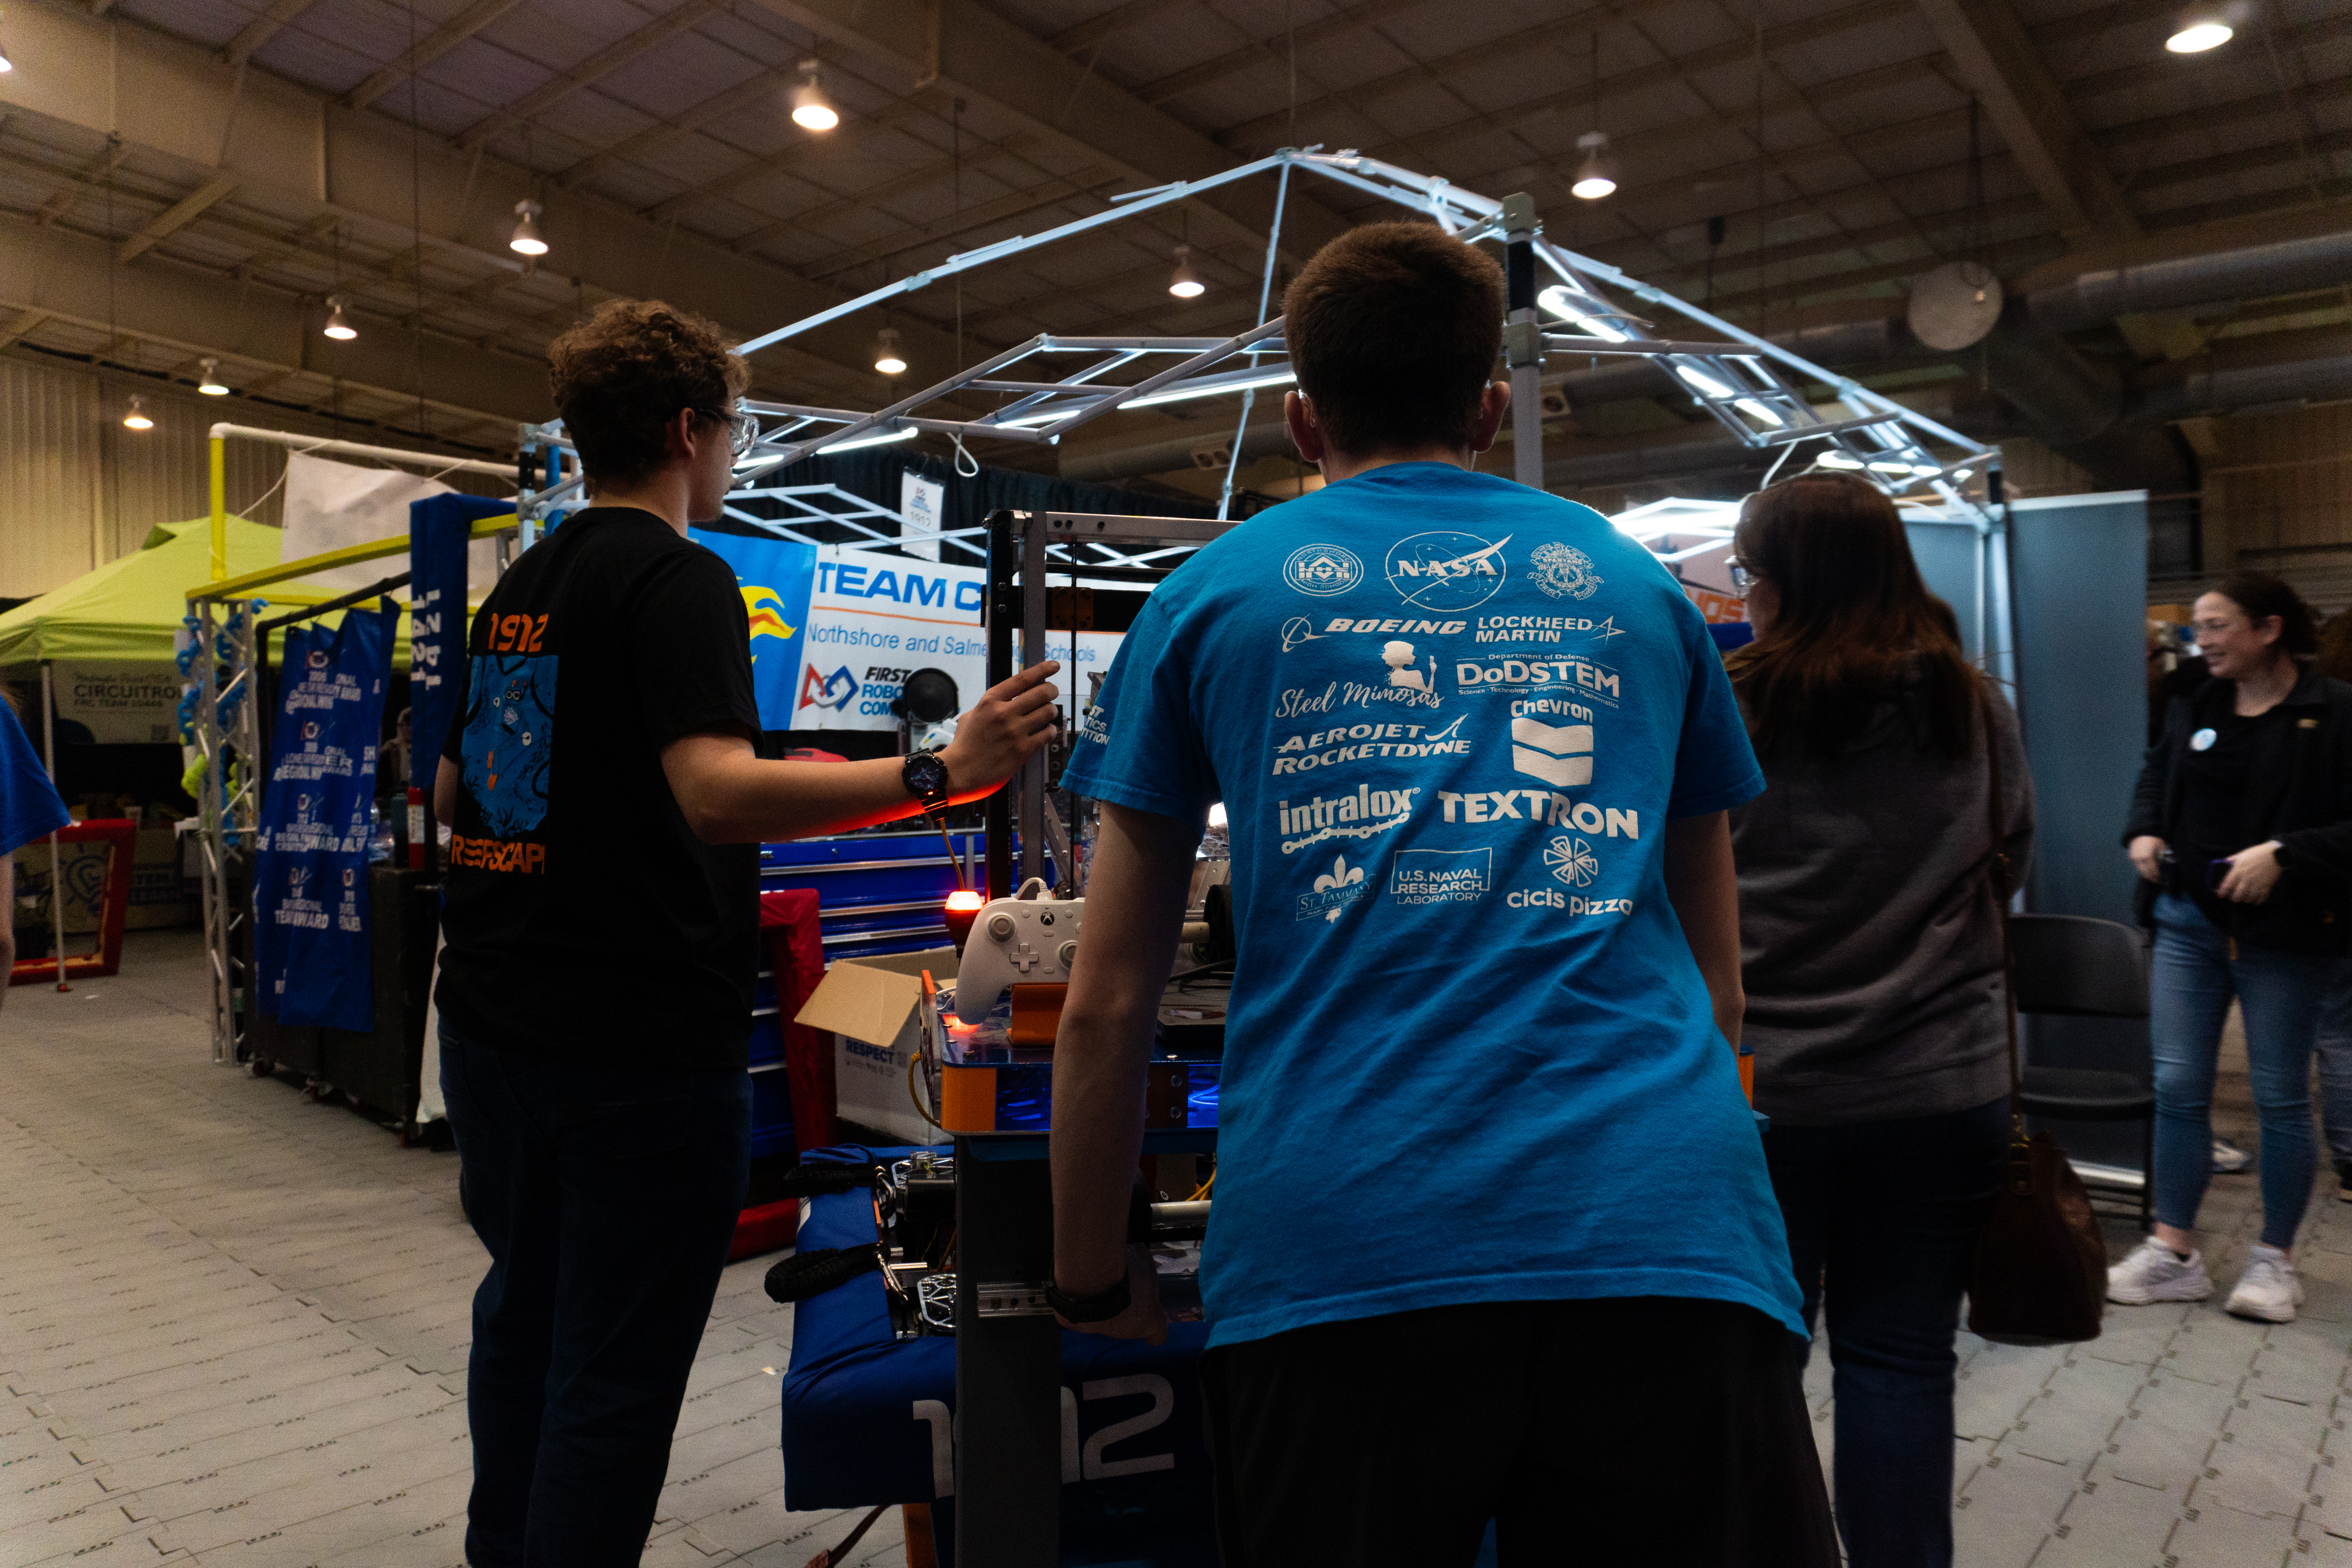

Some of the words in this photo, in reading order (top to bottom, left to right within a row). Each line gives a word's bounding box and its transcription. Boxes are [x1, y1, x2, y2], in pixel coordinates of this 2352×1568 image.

[1297, 548, 1350, 561] NORTHSHORE
[1397, 558, 1498, 577] NASA
[818, 562, 946, 608] TEAM
[955, 581, 982, 611] C
[1539, 583, 1556, 597] PRIDE
[1578, 585, 1595, 598] POWER
[488, 612, 549, 653] 1912
[1325, 618, 1467, 635] BOEING
[1477, 616, 1592, 630] LOCKHEED
[807, 623, 900, 649] Northshore
[905, 635, 940, 653] and
[944, 637, 986, 657] Salme
[1475, 630, 1561, 643] MARTIN
[865, 666, 911, 683] FIRST
[1457, 661, 1619, 698] DoDSTEM
[862, 684, 904, 699] ROBO
[1275, 681, 1337, 718] Steel
[1343, 682, 1445, 709] Mimosas
[1534, 685, 1575, 694] Engineering
[1579, 689, 1619, 709] Mathematics
[860, 701, 896, 716] COM
[1511, 699, 1593, 724] Chevron
[1085, 716, 1107, 733] TICS
[1273, 724, 1426, 753] AEROJET
[1272, 740, 1471, 775] ROCKETDYNE
[1438, 789, 1639, 840] TEXTRON
[1399, 870, 1427, 882] U.S.
[1429, 868, 1482, 882] NAVAL
[1398, 880, 1482, 895] RESEARCH
[1397, 892, 1481, 905] LABORATORY
[1507, 887, 1565, 909] cicis
[1569, 896, 1633, 917] pizza
[846, 1038, 895, 1065] RESPECT
[913, 1373, 1175, 1500] 112
